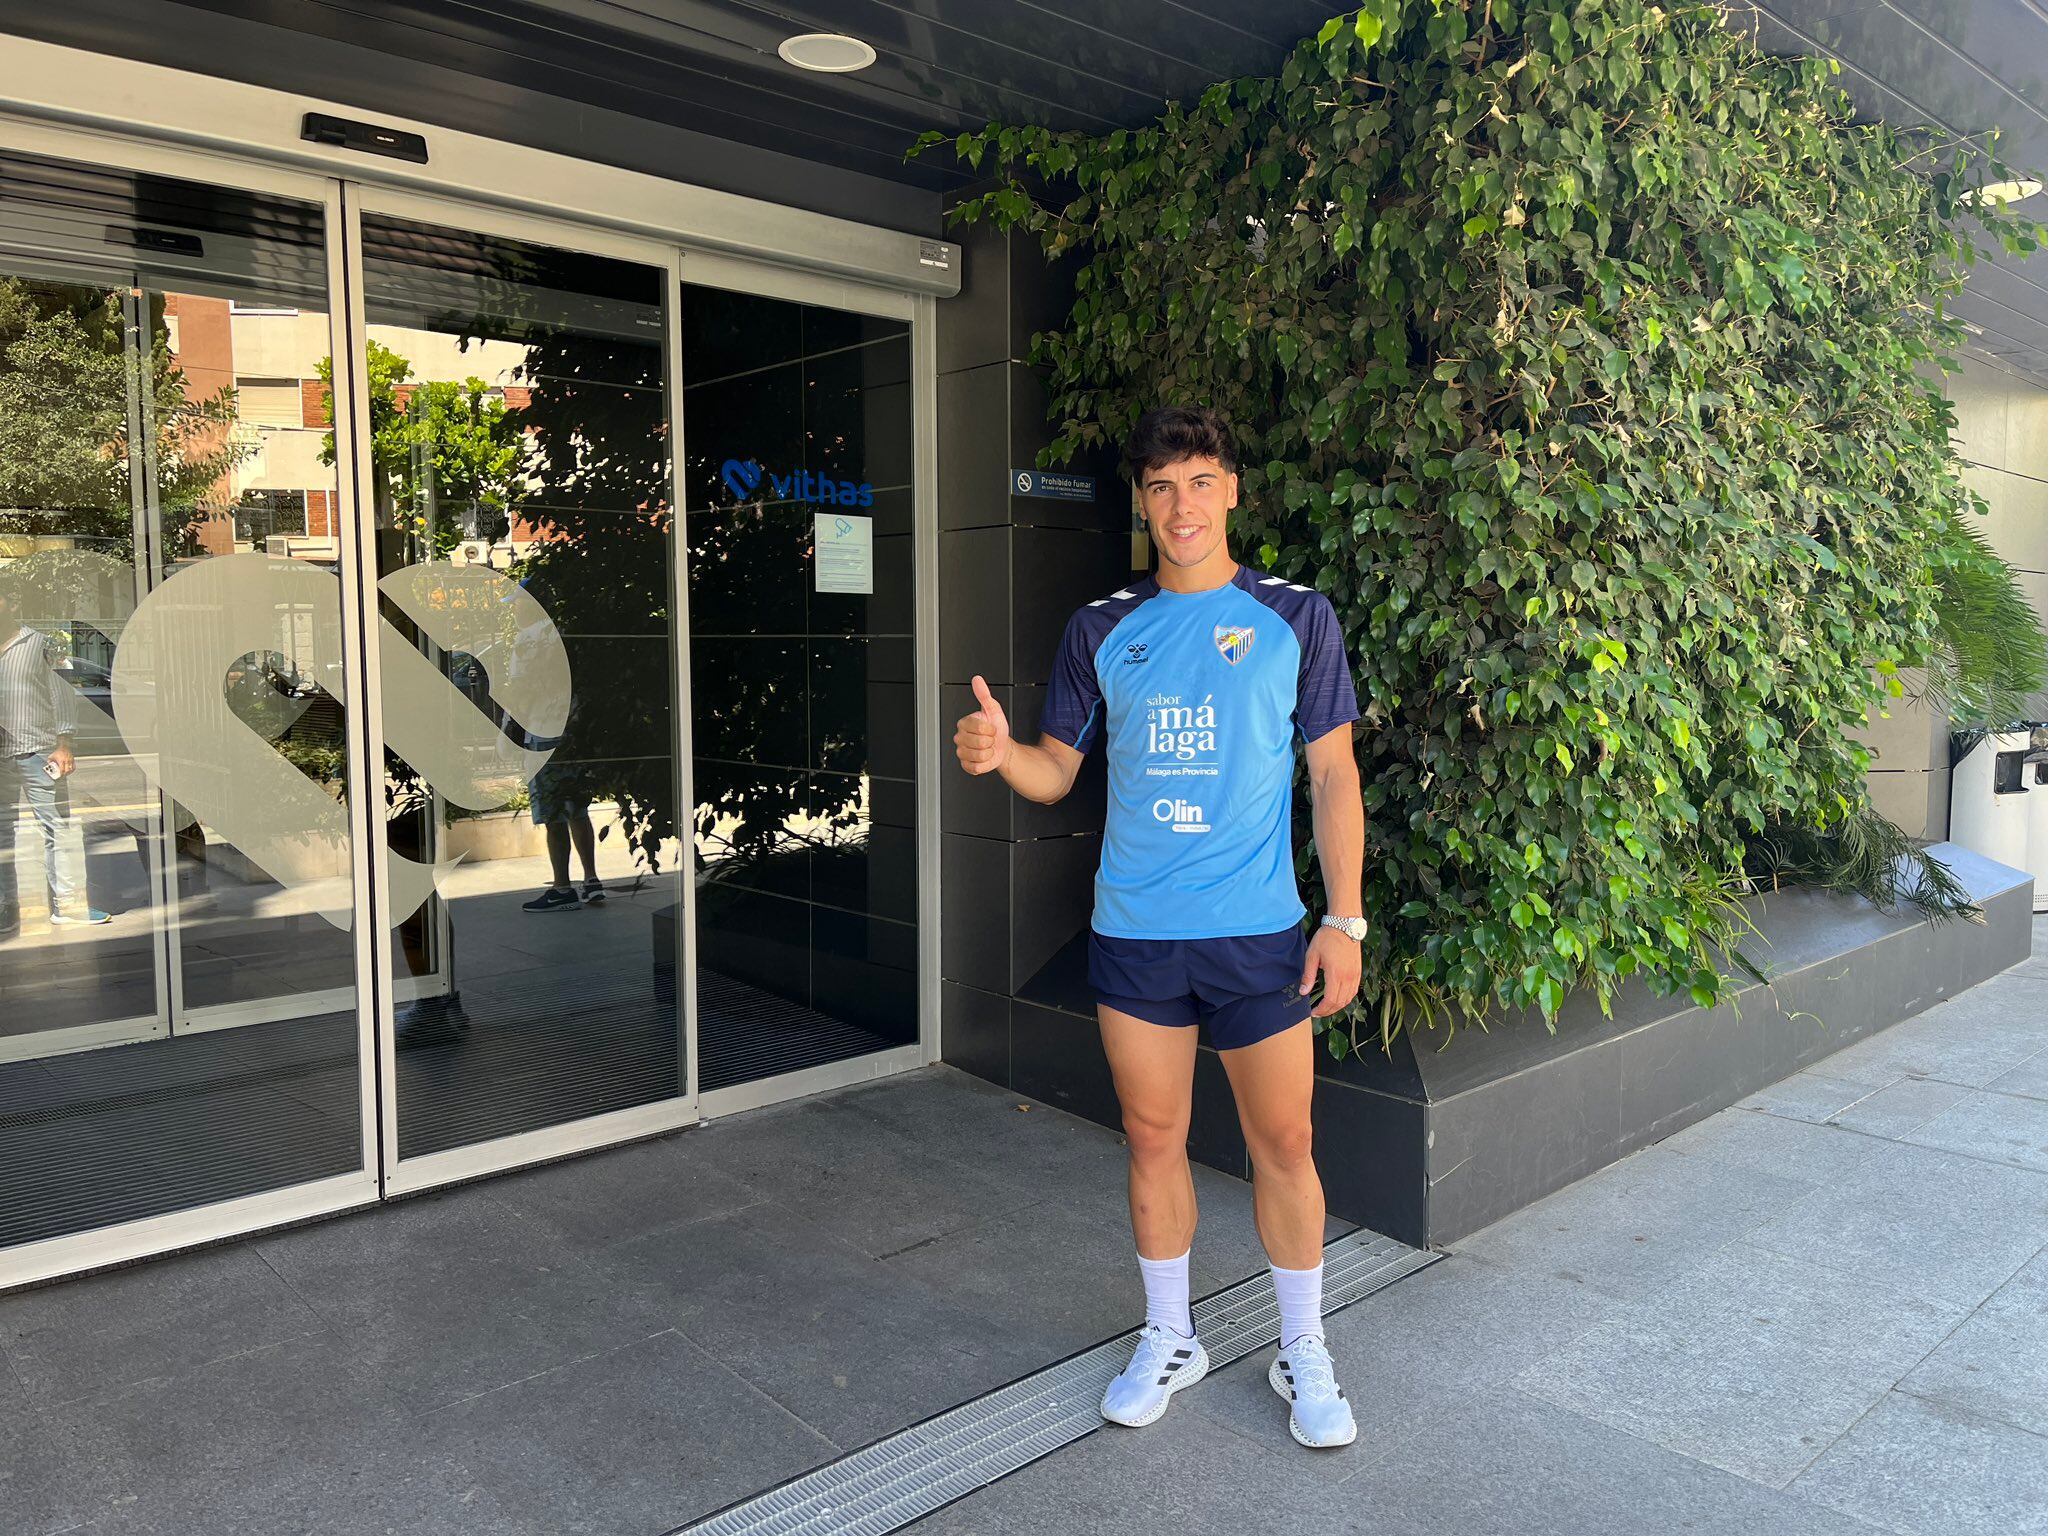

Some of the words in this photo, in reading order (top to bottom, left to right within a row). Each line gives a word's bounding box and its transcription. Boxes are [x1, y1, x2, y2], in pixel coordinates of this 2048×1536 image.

[770, 468, 874, 507] vithas
[1041, 476, 1072, 488] Prohibido
[1073, 479, 1092, 489] fumar
[1146, 692, 1182, 706] sabor
[1147, 708, 1157, 720] a
[1158, 694, 1218, 730] má
[1148, 723, 1218, 761] laga
[1146, 767, 1172, 777] Málaga
[1182, 767, 1219, 776] Provincia
[1152, 798, 1203, 822] Olin
